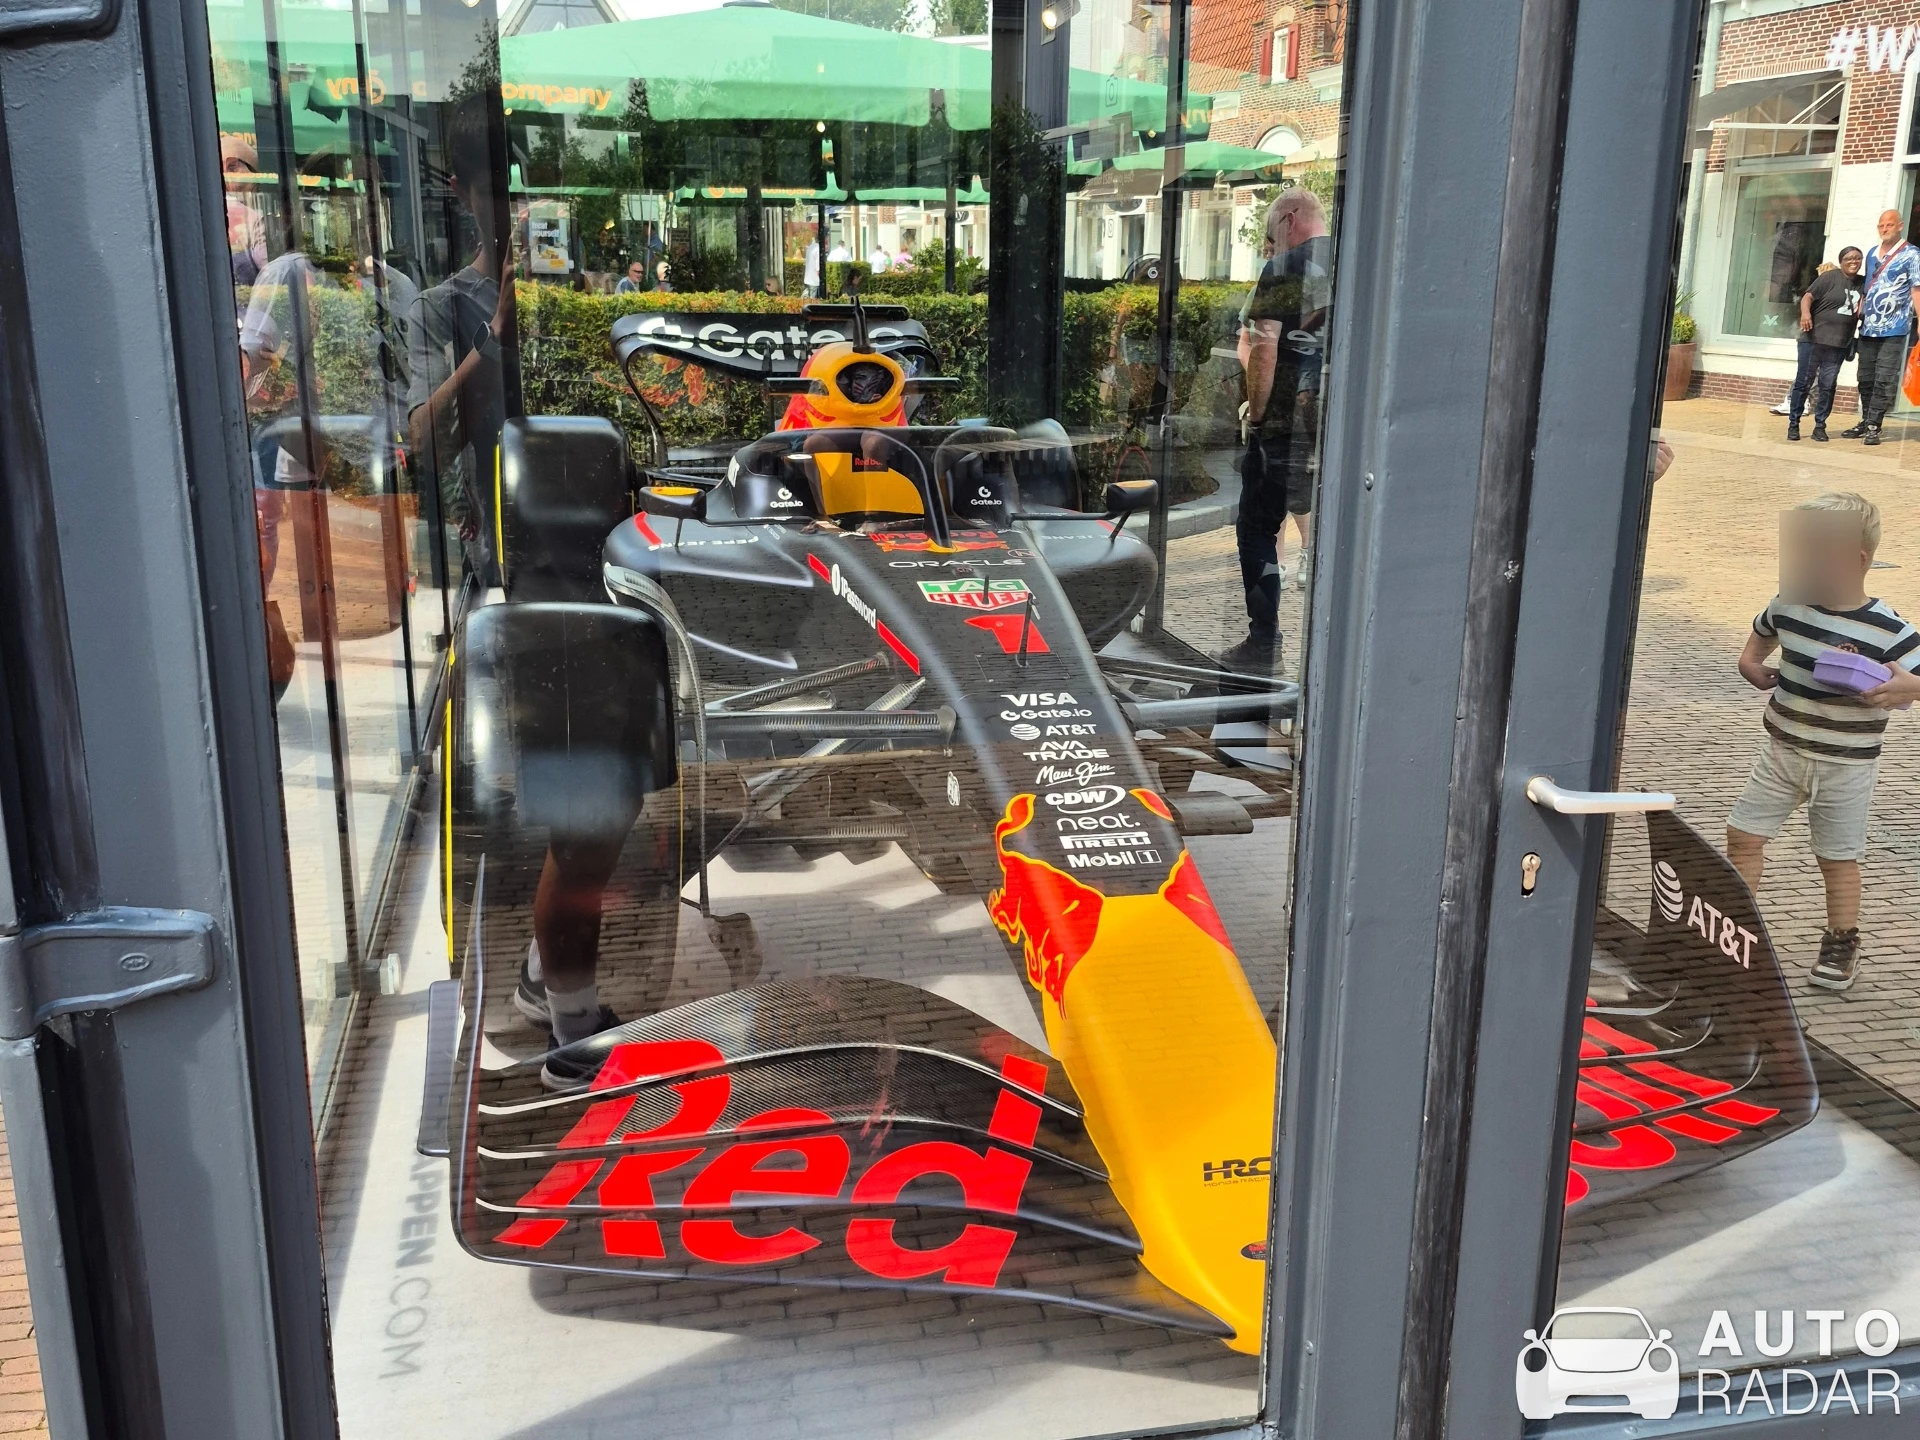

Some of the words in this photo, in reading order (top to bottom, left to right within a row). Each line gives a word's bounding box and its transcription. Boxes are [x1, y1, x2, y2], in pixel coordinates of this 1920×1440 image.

[1825, 25, 1920, 73] #W
[501, 82, 612, 111] ompany
[698, 322, 905, 361] Gateo
[770, 500, 803, 508] Gate.io
[970, 498, 1002, 506] Gate.io
[889, 558, 1026, 568] ORACLE
[927, 580, 1021, 593] TAG
[840, 576, 877, 630] 1Password
[931, 592, 1029, 608] HEUER
[1000, 692, 1079, 707] VISA
[1020, 708, 1093, 720] Gate.io
[1045, 723, 1098, 737] AT&T
[1040, 740, 1088, 751] AVA
[1023, 748, 1110, 762] TRADE
[1035, 764, 1075, 785] Maui
[1074, 761, 1116, 787] Jim
[1045, 789, 1107, 806] CDW
[1059, 831, 1152, 850] PIRELLI
[1067, 850, 1136, 868] Mobil
[1686, 895, 1758, 970] AT&T
[493, 1038, 1049, 1288] Red
[1203, 1156, 1271, 1182] HRC
[378, 1148, 446, 1380] APPEN.COM
